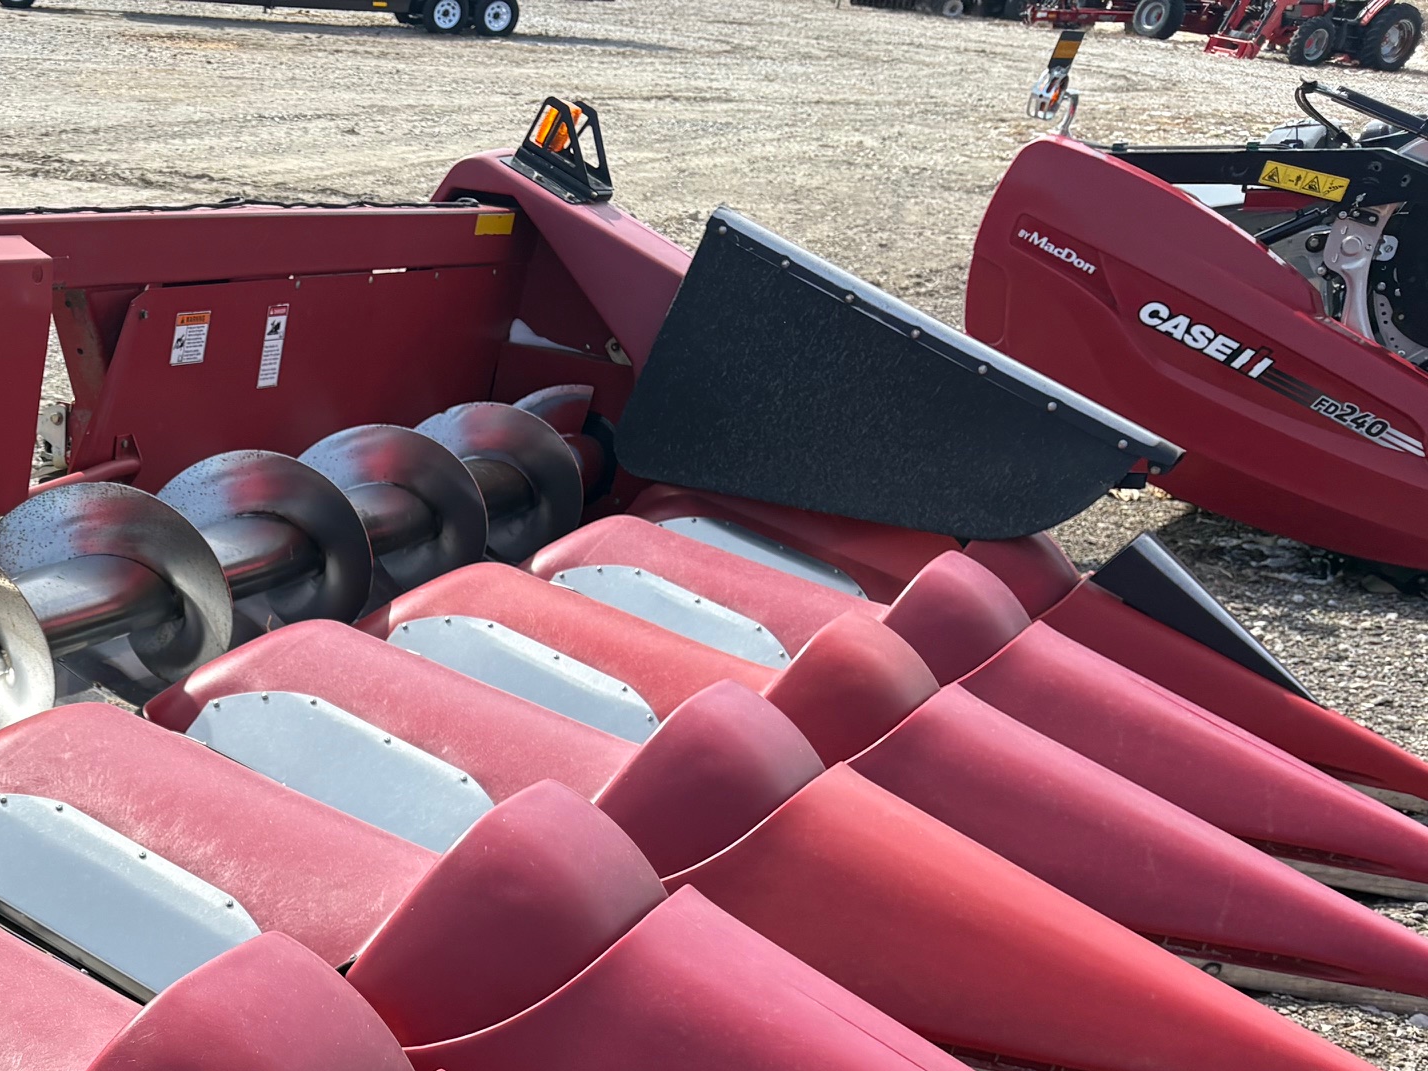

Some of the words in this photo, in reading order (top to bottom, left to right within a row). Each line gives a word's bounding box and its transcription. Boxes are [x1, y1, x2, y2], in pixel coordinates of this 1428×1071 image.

[1018, 228, 1031, 240] BY
[1028, 231, 1097, 275] MacDon
[1138, 301, 1241, 363] CASE
[1312, 396, 1389, 438] FD240
